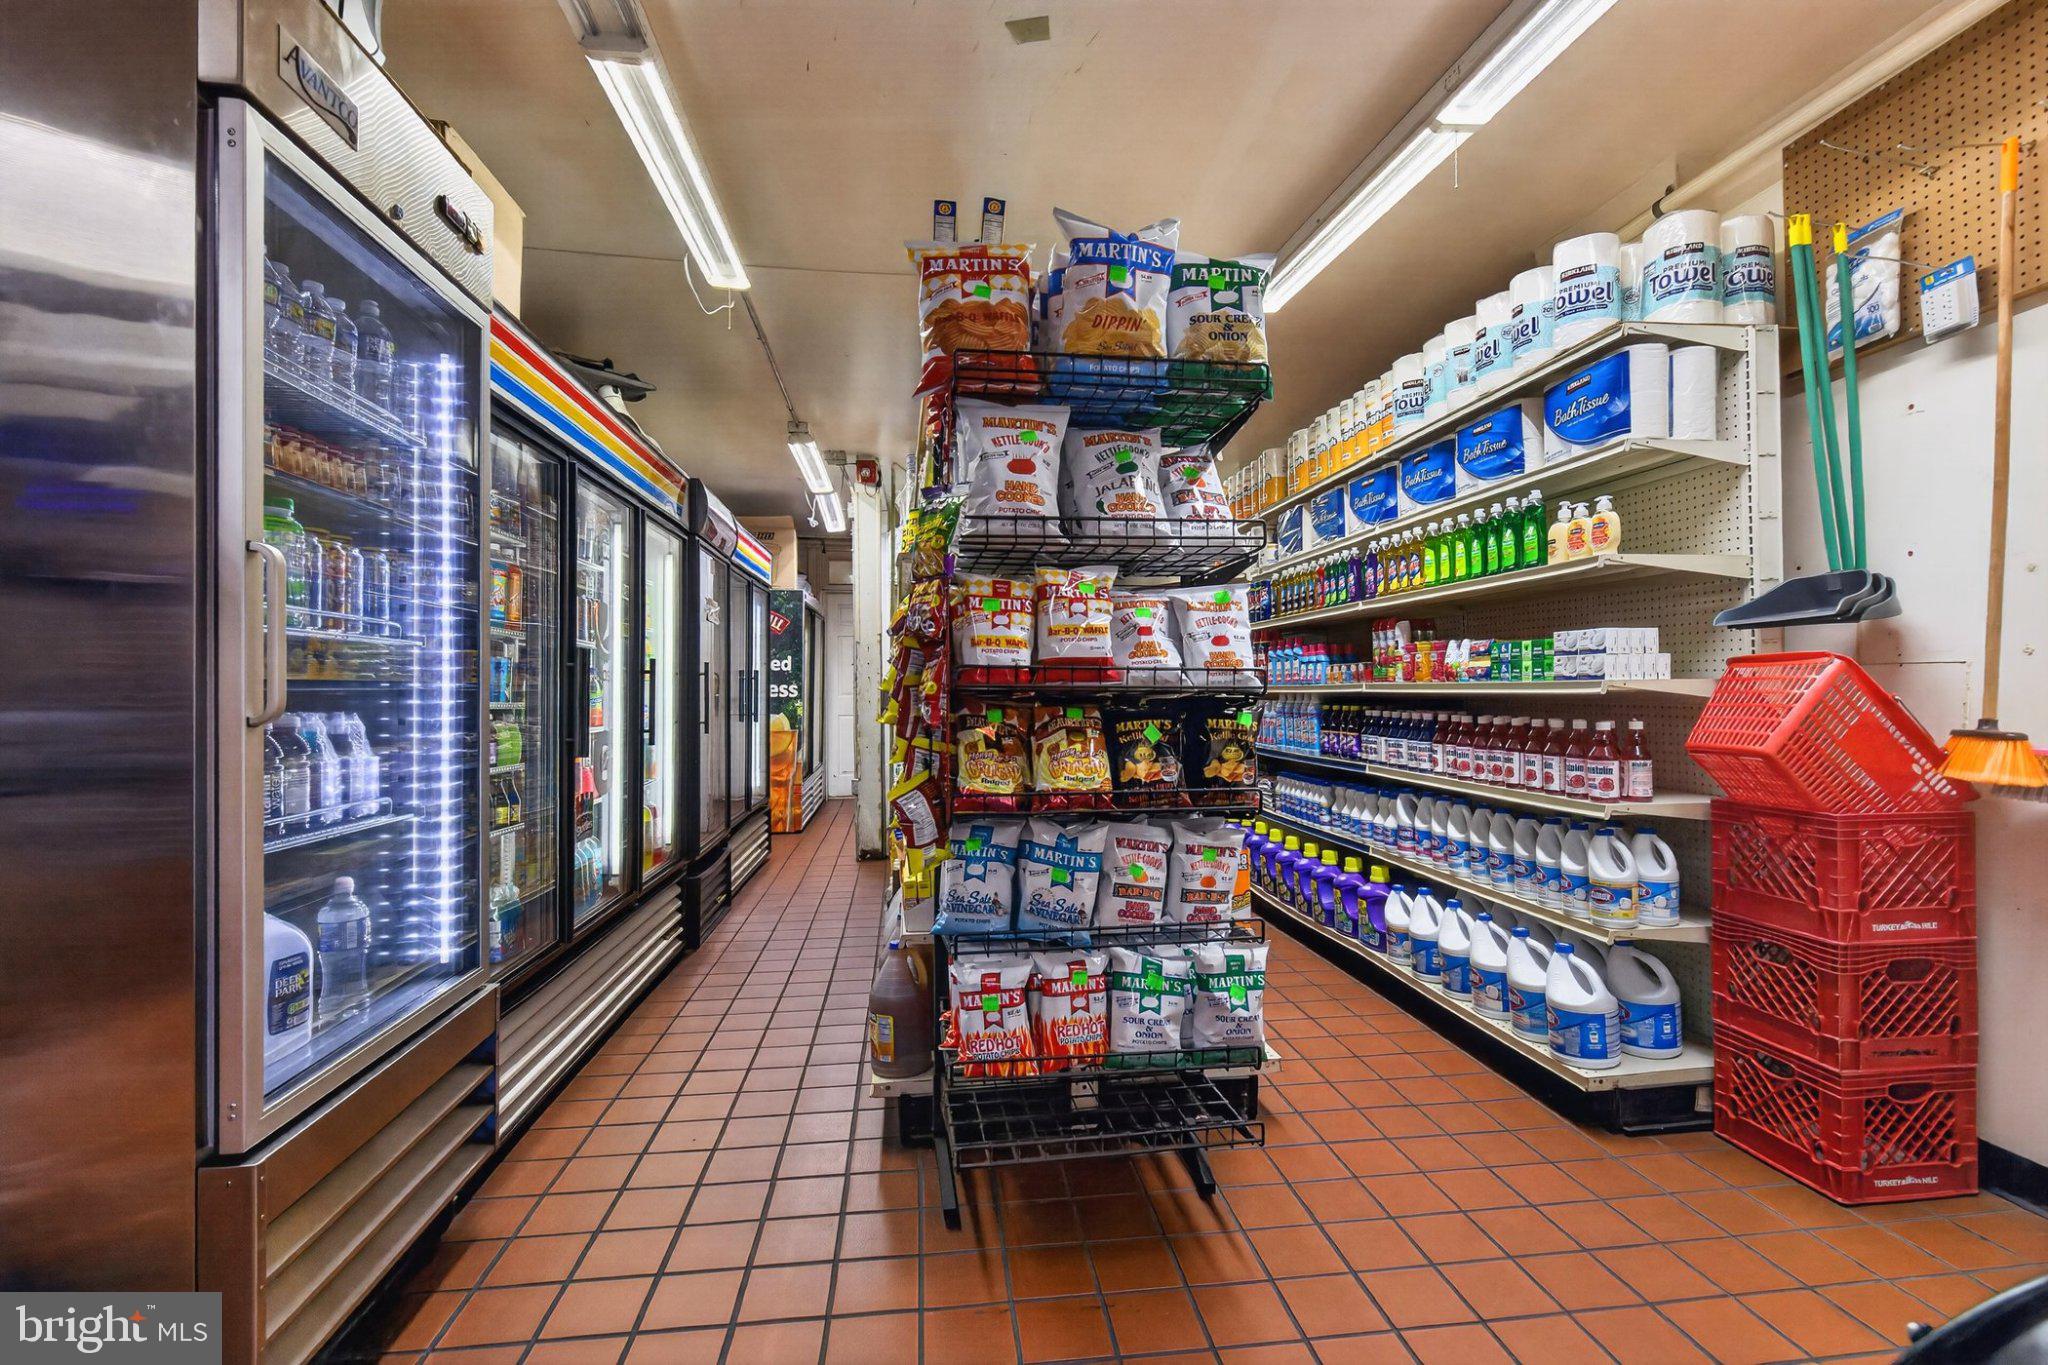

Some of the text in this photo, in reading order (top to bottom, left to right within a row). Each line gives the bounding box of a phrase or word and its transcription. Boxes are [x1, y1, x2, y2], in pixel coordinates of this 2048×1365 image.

[282, 45, 358, 129] AVANTCO
[1079, 242, 1162, 269] MARTIN'S
[929, 258, 1019, 272] MARTIN'S
[1663, 260, 1706, 273] PREMIUM
[1650, 263, 1716, 294] Towel
[1723, 268, 1773, 292] Towe
[1554, 281, 1614, 311] owel
[1092, 314, 1148, 332] DIPPIN'
[1189, 314, 1222, 325] SOUR
[1223, 324, 1234, 332] &
[1208, 331, 1248, 343] ONION
[1089, 363, 1140, 373] POATO CHPS
[1554, 393, 1610, 427] Bath Tissue
[982, 417, 1057, 436] MARTIN'S
[1083, 432, 1152, 448] MARTIN'S
[1463, 439, 1508, 464] Bath Tissue
[1421, 467, 1442, 483] Tissue
[1005, 480, 1039, 493] HAND
[1095, 474, 1160, 498] JALAPÑO
[996, 490, 1046, 507] COOKED
[969, 596, 1033, 612] MTIN'S
[1115, 720, 1172, 733] MARTN'S
[1207, 718, 1258, 731] MART'S
[1034, 847, 1097, 868] MARTIN'S
[1185, 844, 1237, 858] MAN'S
[946, 888, 992, 904] Sea Salt
[1030, 893, 1078, 913] Sea Salt
[1872, 923, 1900, 931] TURKEY
[274, 974, 300, 989] DEER
[1051, 977, 1106, 994] MARN'S
[1121, 976, 1182, 992] MARN'S
[1209, 974, 1266, 989] MARTIN'S
[275, 983, 301, 998] PARK
[963, 991, 1021, 1007] MAN'S
[1123, 1017, 1145, 1025] SOUR
[1216, 1014, 1237, 1023] SOUR
[1058, 1020, 1105, 1037] RED HOT
[1135, 1031, 1163, 1039] ONION
[1226, 1028, 1252, 1036] ONION
[970, 1036, 1021, 1053] RED HOT
[1060, 1033, 1103, 1045] POTATO CHIPS
[974, 1048, 1020, 1060] POTATO CHIPS
[1874, 1178, 1900, 1187] TURKEY
